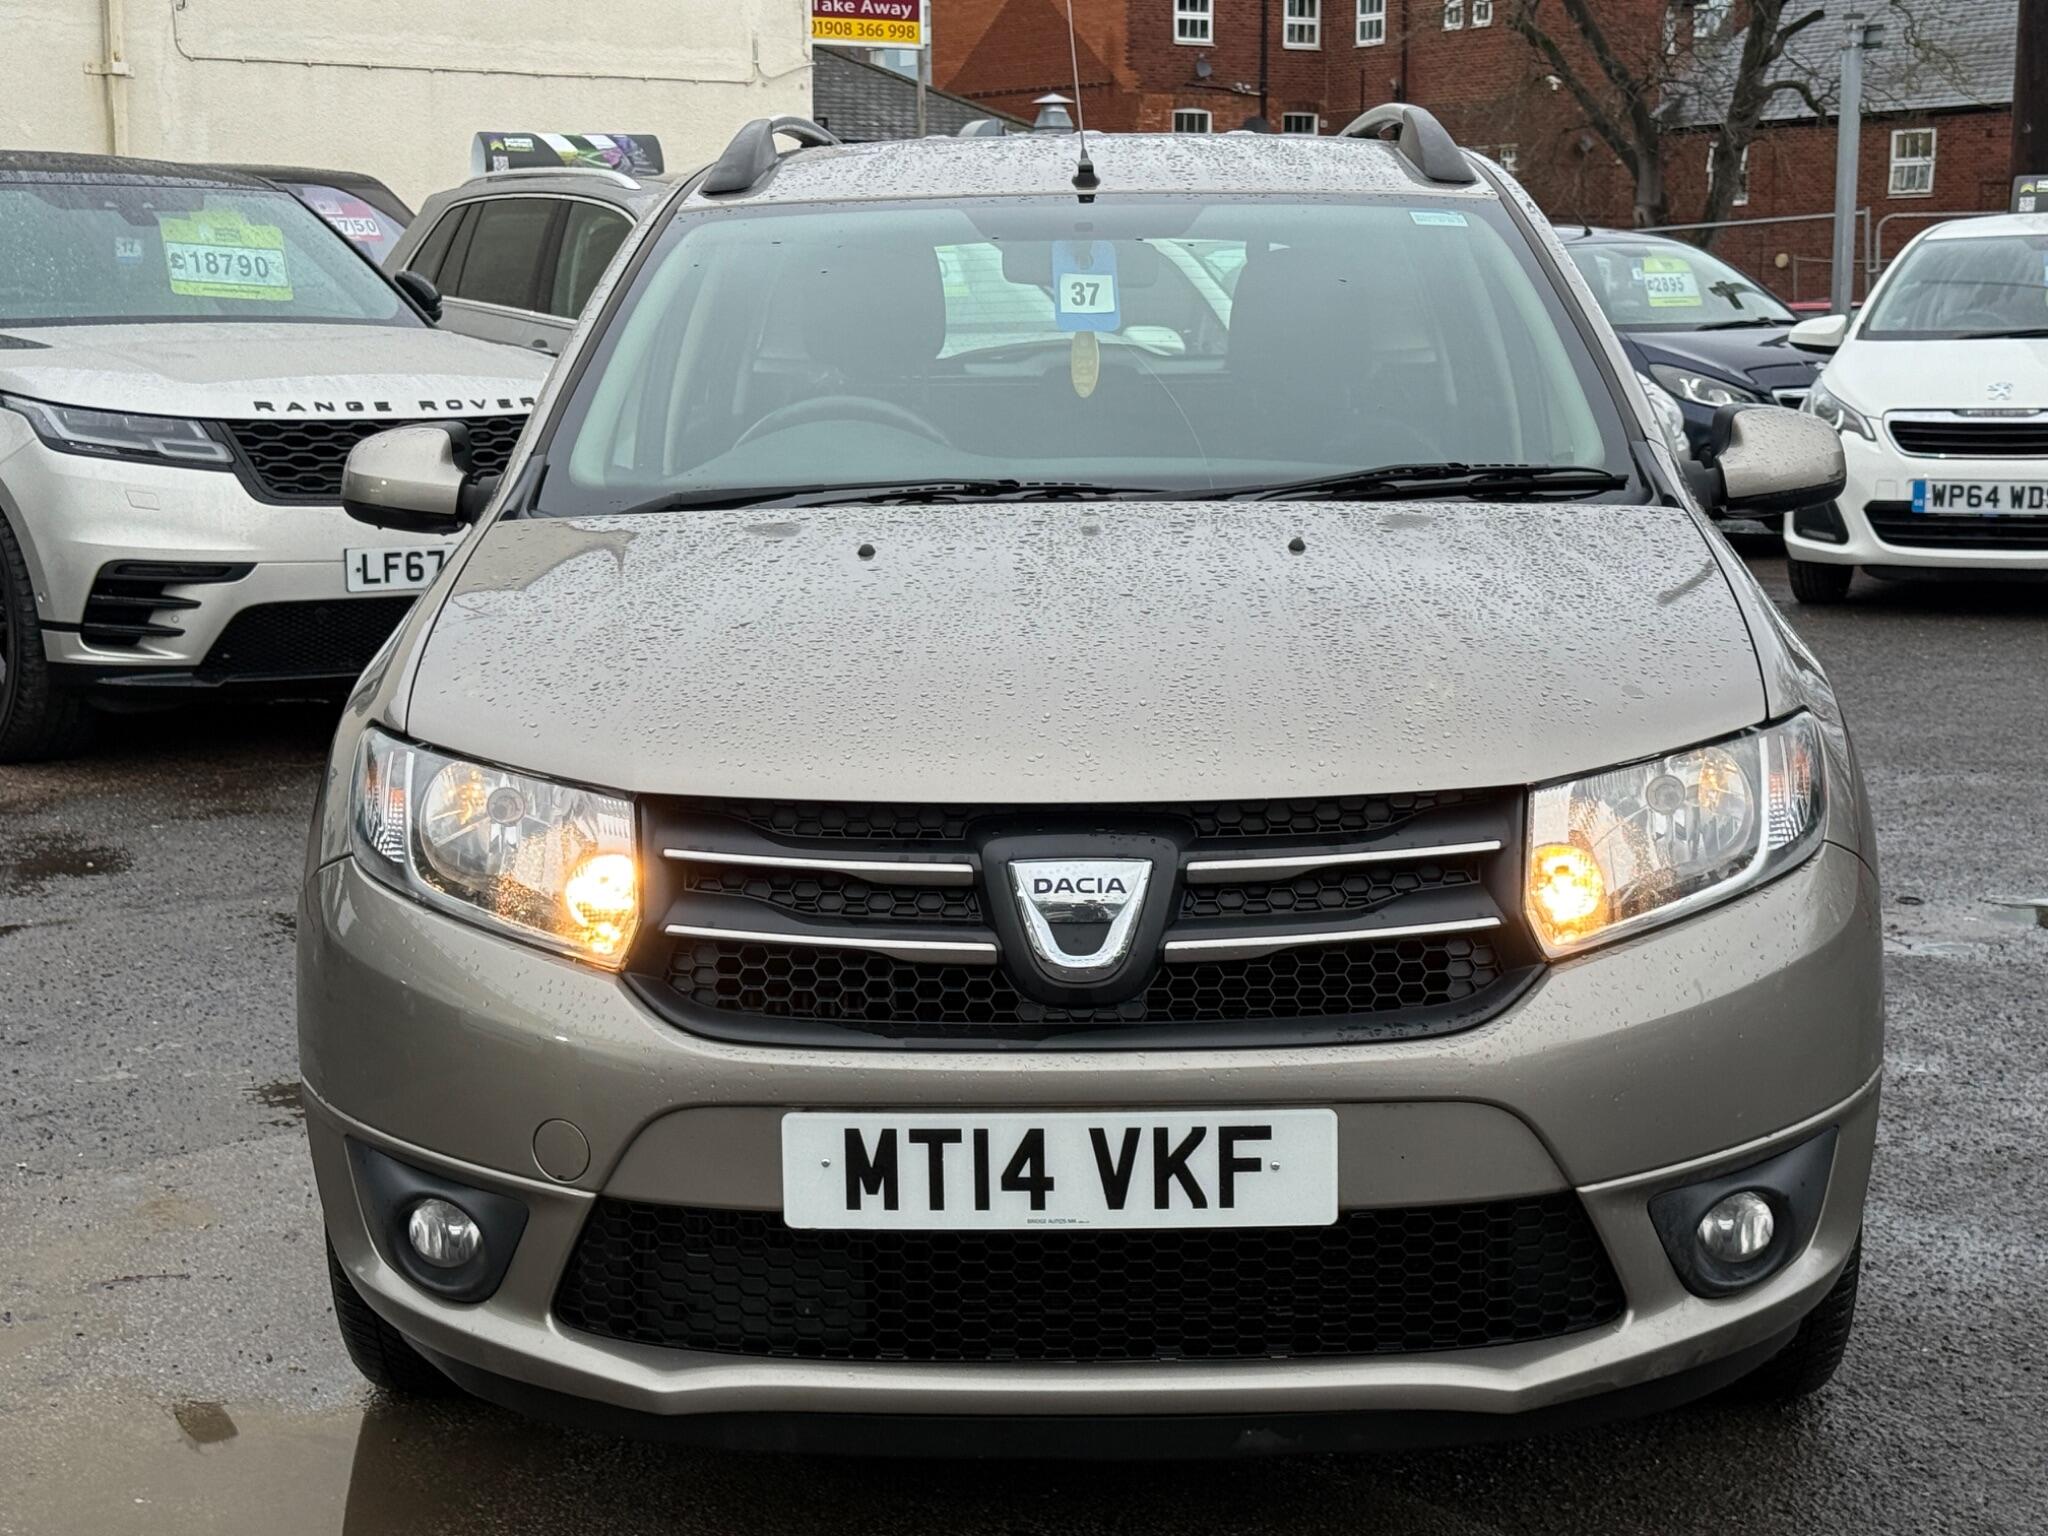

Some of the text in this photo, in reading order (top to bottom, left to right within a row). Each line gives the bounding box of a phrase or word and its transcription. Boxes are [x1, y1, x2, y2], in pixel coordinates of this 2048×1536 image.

[861, 0, 913, 20] Away
[857, 22, 885, 38] 366
[888, 24, 916, 40] 998
[170, 251, 270, 279] £18790
[1070, 281, 1100, 307] 37
[252, 396, 536, 413] RANGE ROVER
[1931, 483, 2048, 510] WP64 WD
[361, 549, 446, 585] LF67
[1033, 878, 1127, 895] DACIA
[844, 1124, 1273, 1212] MT14 VKF
